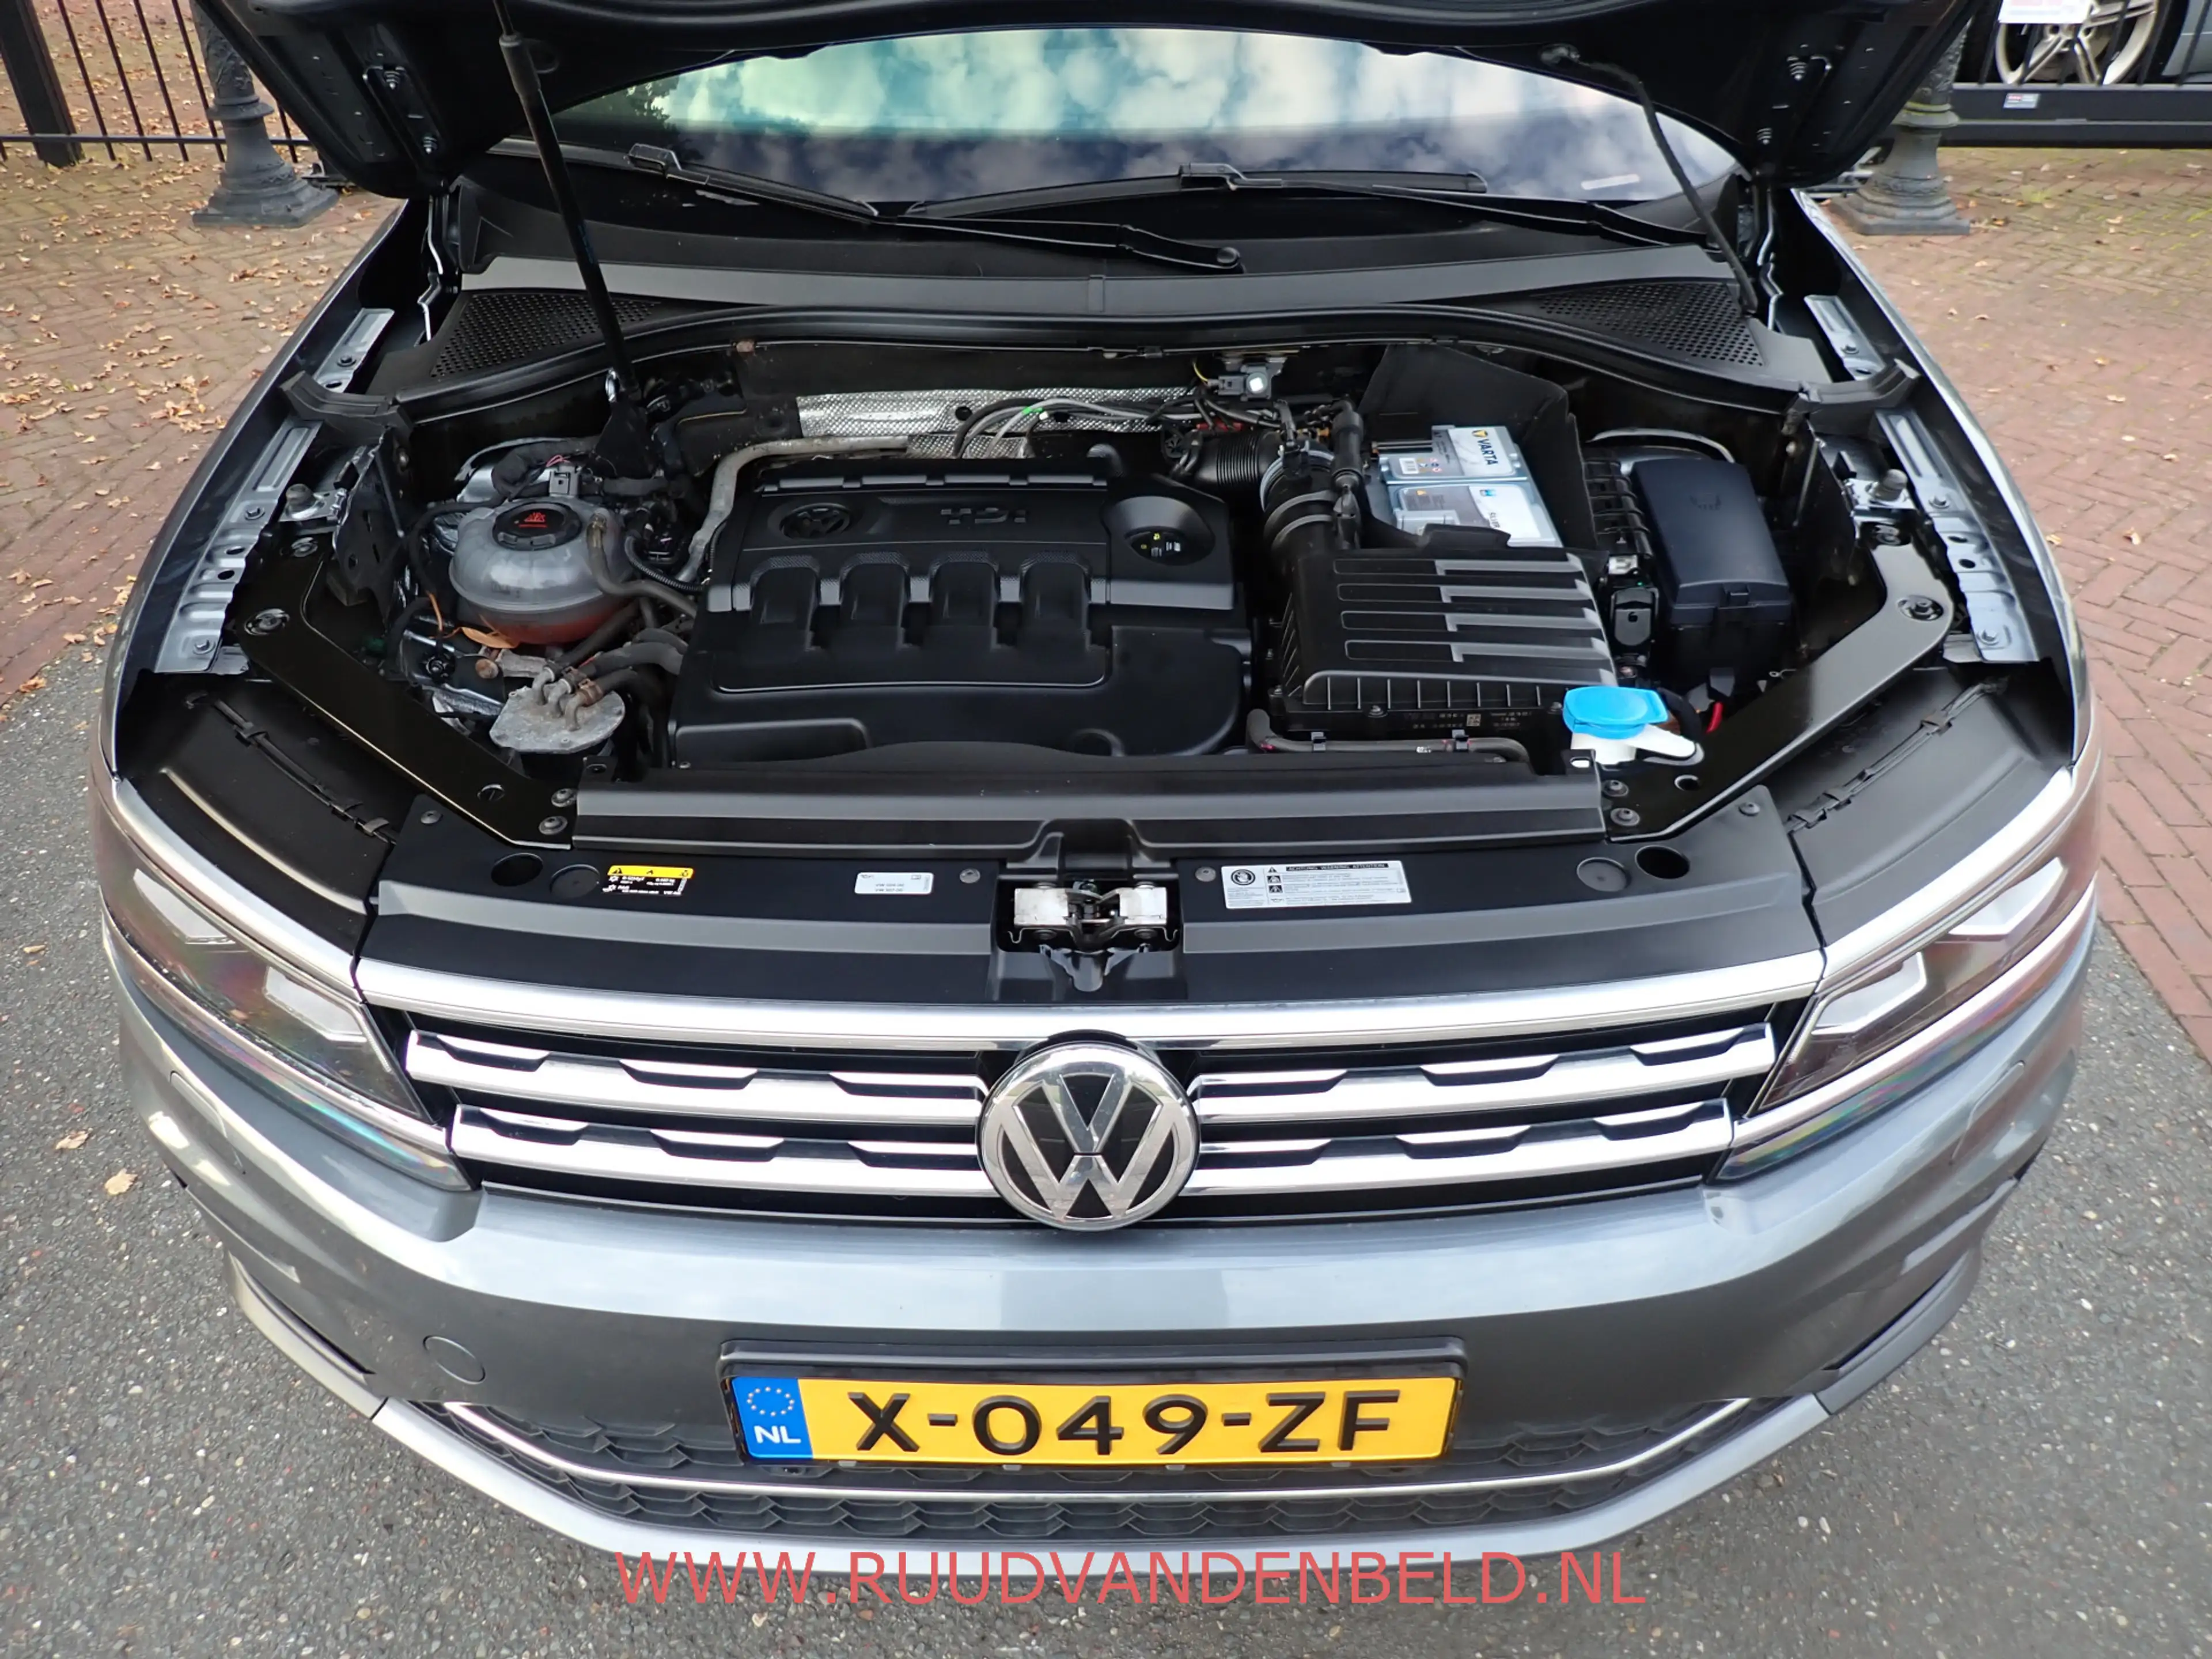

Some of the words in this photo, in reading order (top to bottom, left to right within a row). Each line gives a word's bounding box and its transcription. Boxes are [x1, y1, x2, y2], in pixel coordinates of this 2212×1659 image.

[1478, 439, 1498, 465] VARTA
[992, 1063, 1183, 1222] VW
[754, 1425, 801, 1444] NL
[848, 1391, 1400, 1455] X-049-ZF
